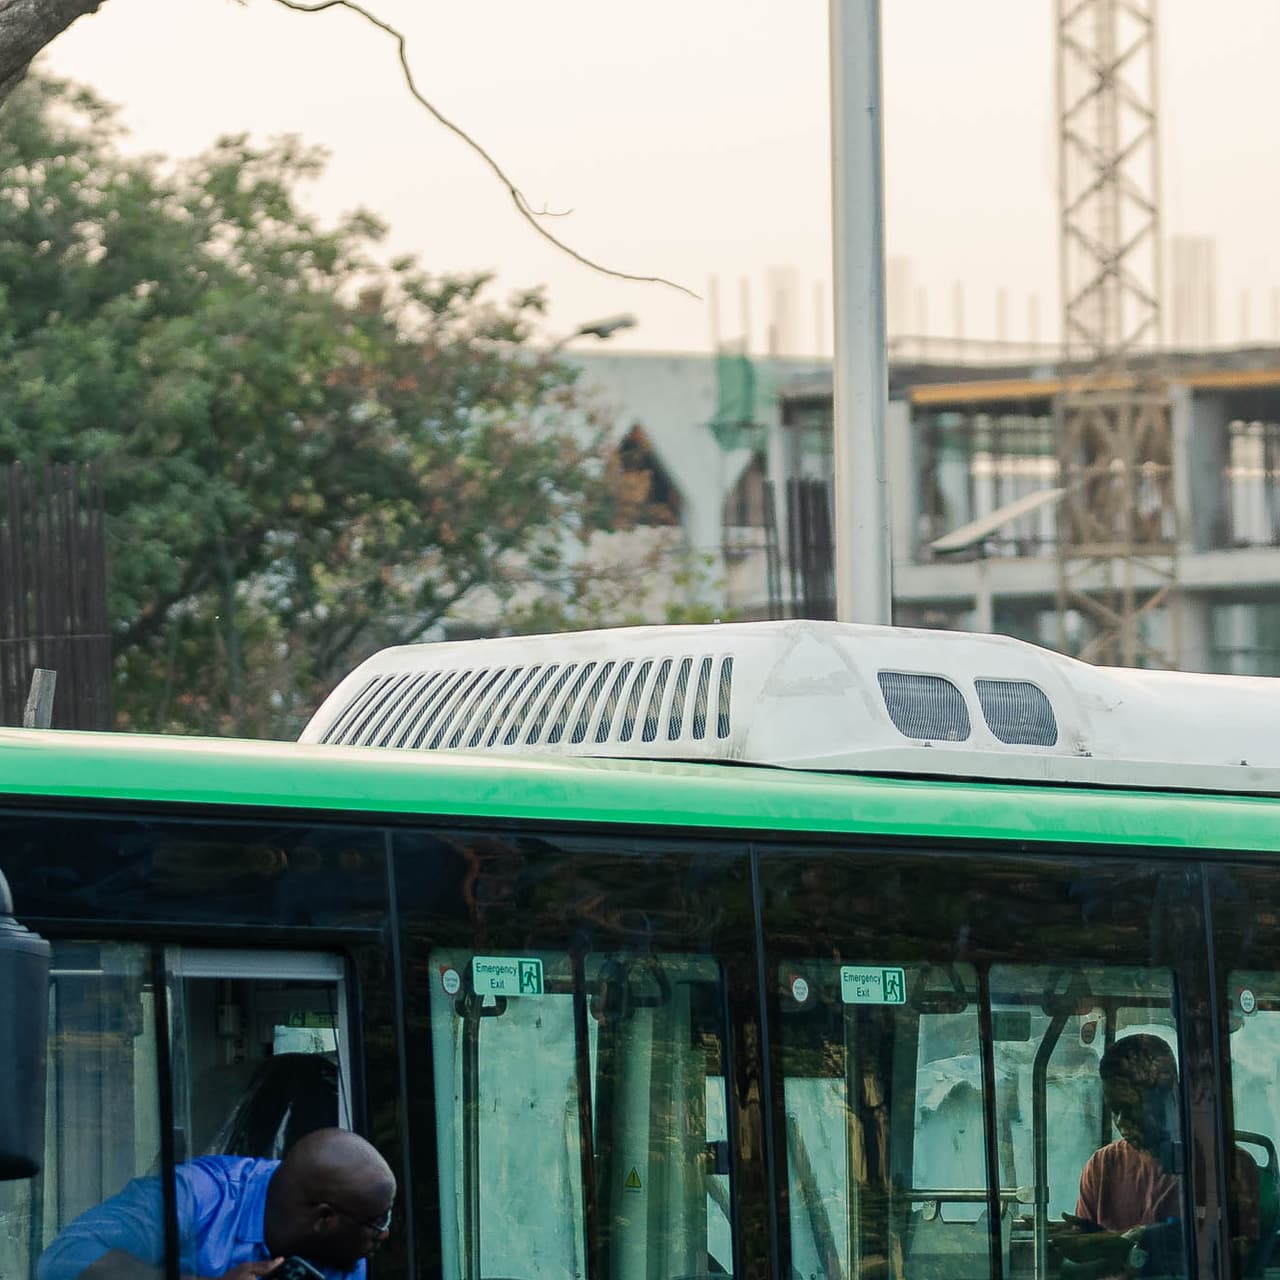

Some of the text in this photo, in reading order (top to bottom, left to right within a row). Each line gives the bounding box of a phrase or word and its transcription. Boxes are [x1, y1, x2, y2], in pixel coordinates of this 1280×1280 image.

[476, 962, 517, 977] Emergency
[843, 971, 881, 984] Emergency
[490, 979, 505, 989] Exit
[856, 987, 870, 998] Exit
